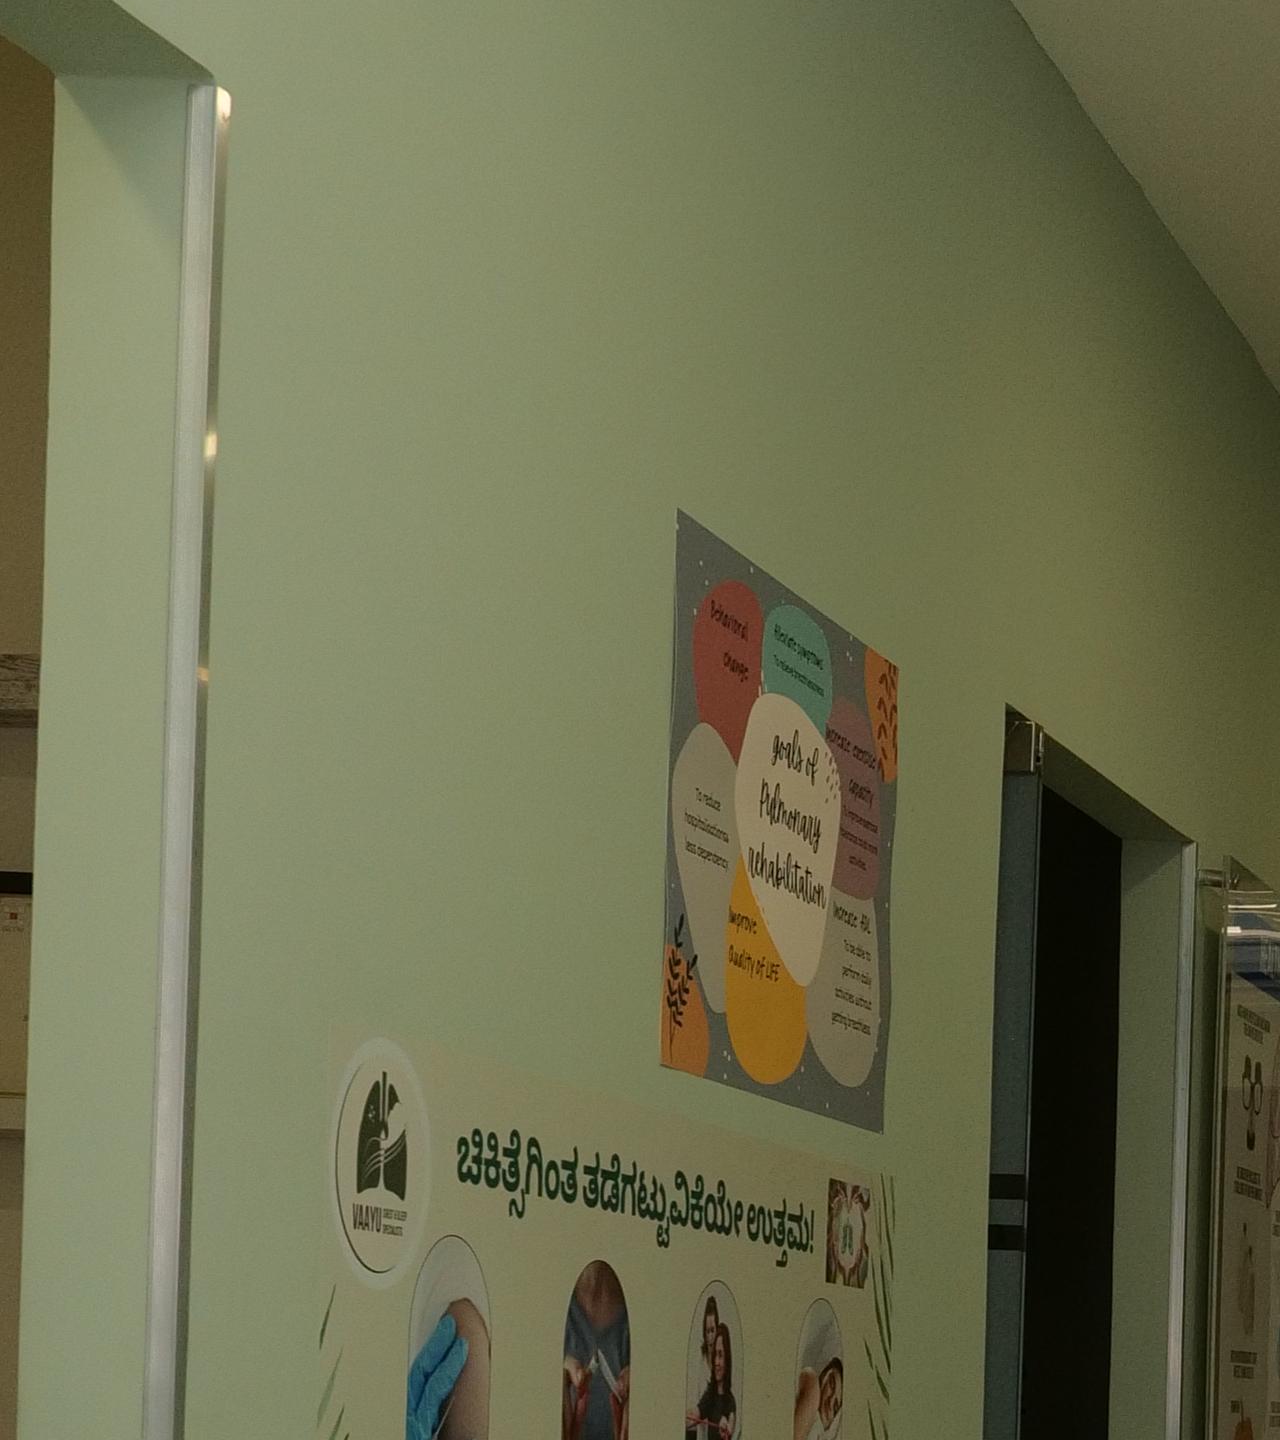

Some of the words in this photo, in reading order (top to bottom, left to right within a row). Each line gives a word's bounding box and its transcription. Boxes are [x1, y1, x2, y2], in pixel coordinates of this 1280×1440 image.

[771, 728, 803, 773] goals
[804, 747, 818, 786] of
[759, 777, 821, 854] Pulmonary
[748, 841, 826, 909] rehabilitation
[352, 1202, 382, 1234] VAAYU
[746, 1198, 814, 1267] ಉತ್ತಮ!
